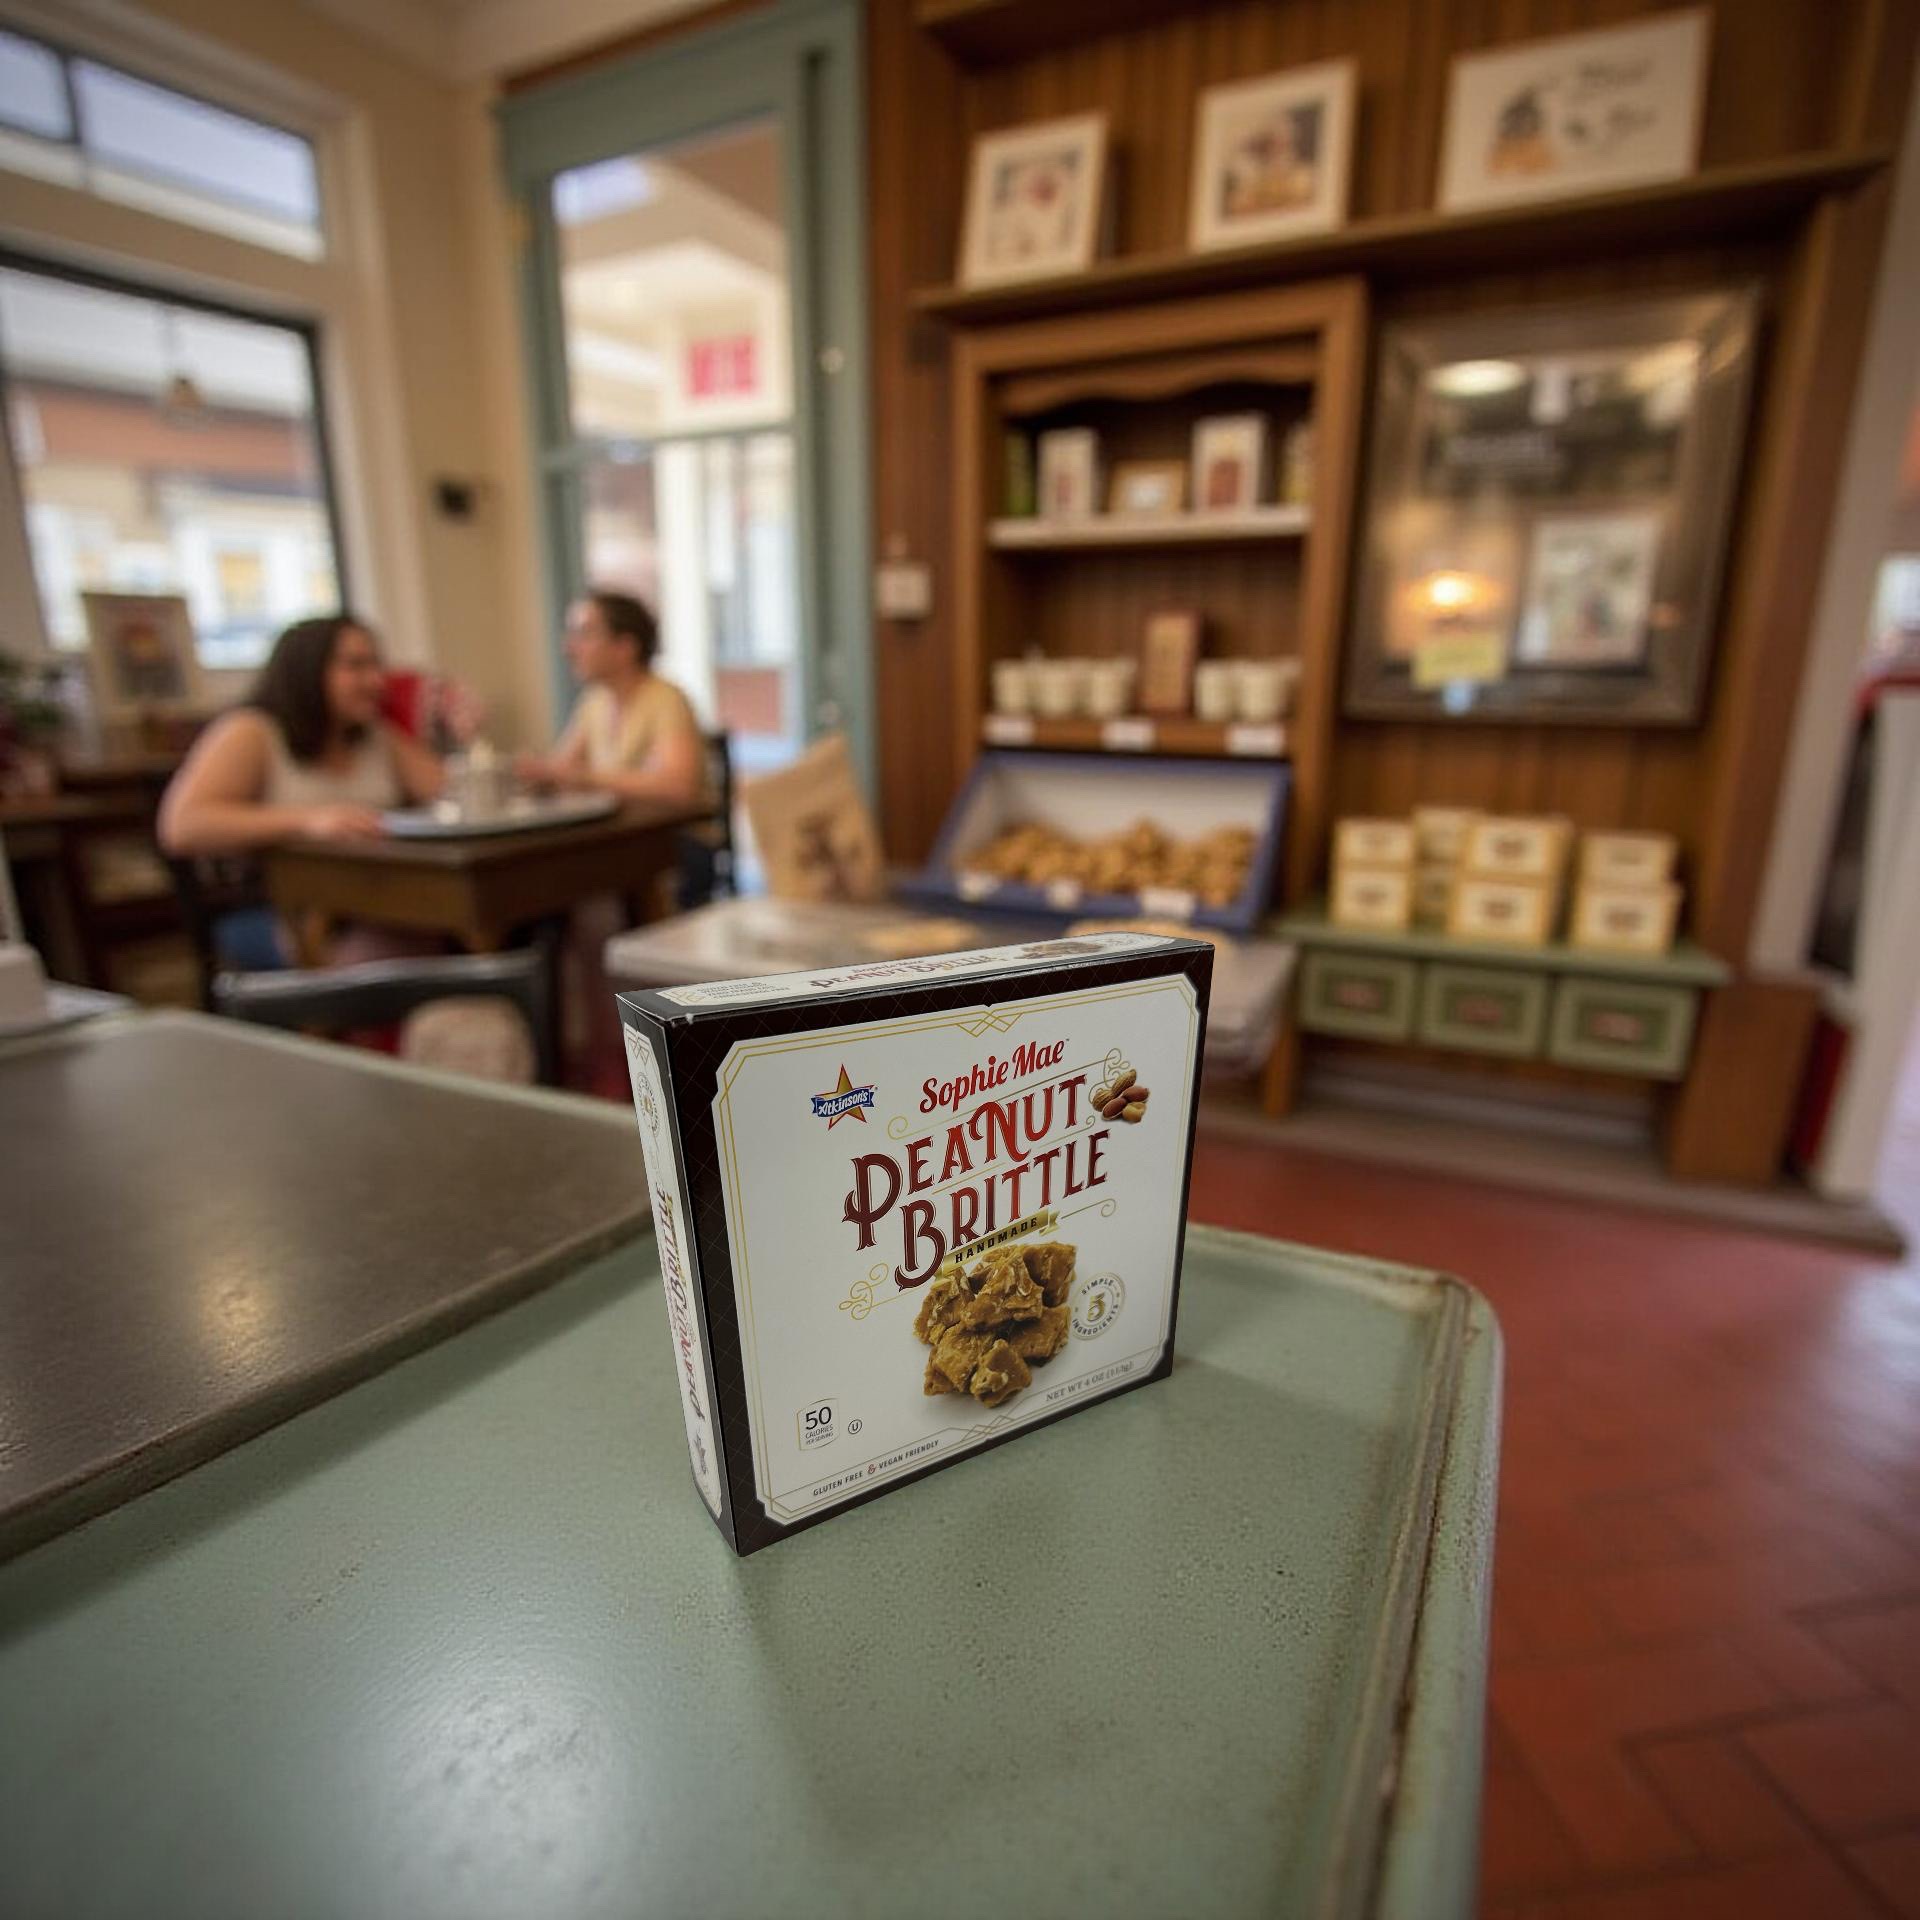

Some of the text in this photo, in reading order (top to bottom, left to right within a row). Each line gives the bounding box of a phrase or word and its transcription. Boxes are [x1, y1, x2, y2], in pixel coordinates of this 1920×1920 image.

[919, 1041, 1065, 1113] Sophie Mae
[818, 1091, 869, 1116] Atkinson's
[842, 1073, 1087, 1251] PEANUT
[894, 1129, 1110, 1292] BRITTLE
[656, 1182, 687, 1309] BRITTLE
[955, 1217, 1038, 1263] HANDMADE
[1082, 1278, 1114, 1295] SIMPLE
[1088, 1292, 1105, 1321] 5
[805, 1406, 832, 1430] 50
[805, 1424, 833, 1439] CALORIES
[813, 1440, 939, 1496] GLUTEN FREE & VEGAN FRIENDLY
